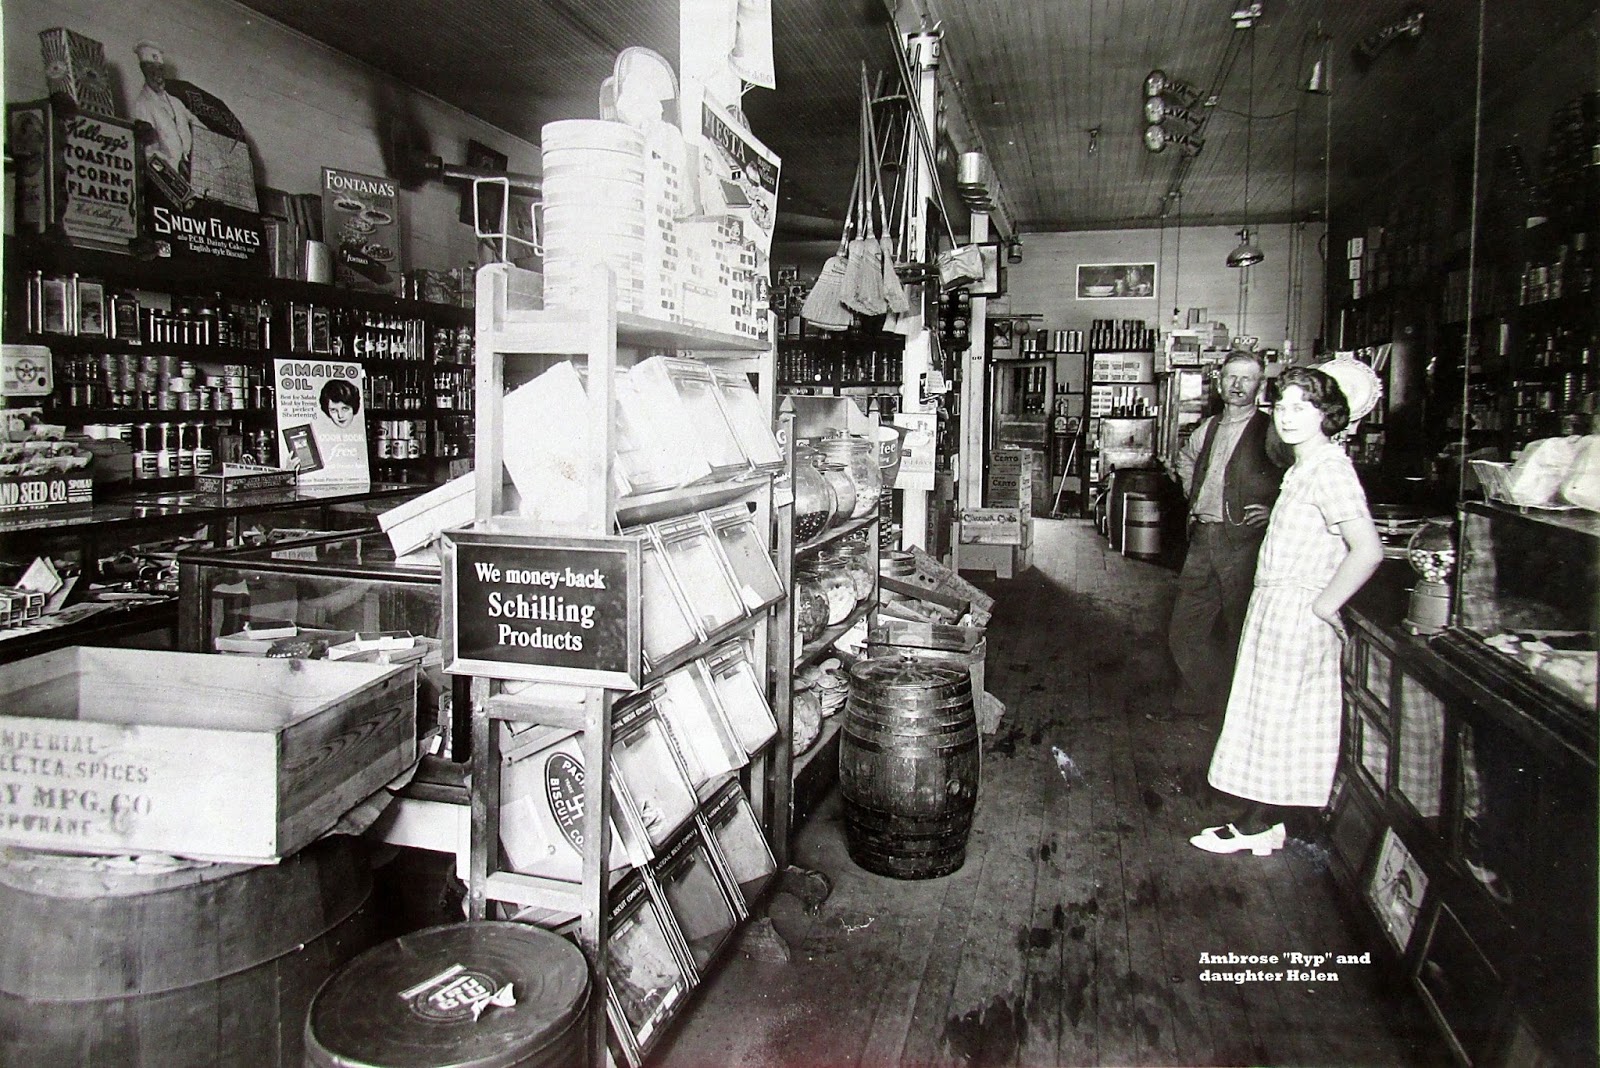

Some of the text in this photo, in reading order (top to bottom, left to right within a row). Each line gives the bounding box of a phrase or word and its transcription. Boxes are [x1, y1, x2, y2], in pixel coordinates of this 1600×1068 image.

[66, 119, 129, 152] Kellogg's
[66, 143, 133, 172] TOASTED
[76, 164, 120, 187] CORN
[326, 169, 395, 198] FONTANA'S
[67, 180, 129, 205] FLAKES
[153, 206, 207, 236] SNOW
[210, 217, 260, 246] FLAKES
[206, 237, 227, 249] Dainty
[228, 241, 246, 252] Cakes
[279, 363, 359, 379] AMAIZO
[281, 378, 313, 391] OIL
[282, 412, 318, 420] Shortening
[20, 481, 48, 504] SEED
[49, 480, 67, 501] CO.
[992, 479, 1017, 487] CERTO
[474, 562, 606, 590] We money-back
[488, 591, 596, 629] Schilling
[498, 623, 583, 651] Products
[550, 778, 574, 827] BISCUIT
